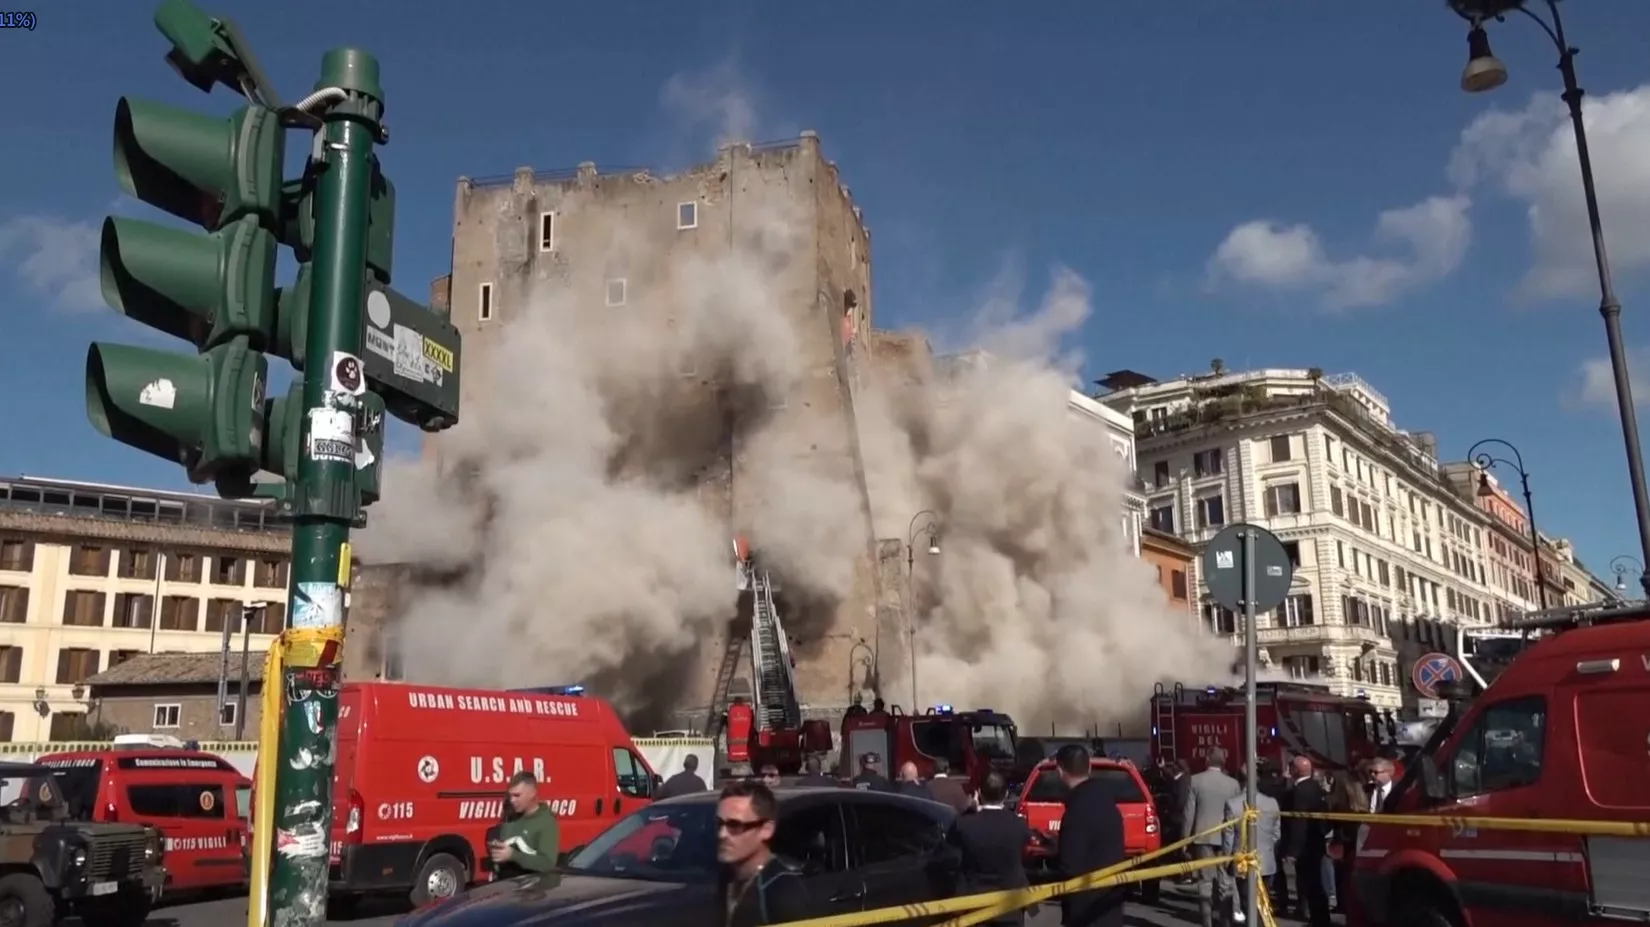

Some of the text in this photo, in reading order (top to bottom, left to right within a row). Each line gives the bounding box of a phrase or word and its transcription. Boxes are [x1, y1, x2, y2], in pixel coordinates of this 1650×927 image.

[408, 692, 579, 716] URBAN SEARCH AND RESCUE
[470, 756, 551, 783] U.S.AR.
[392, 802, 414, 819] 115
[197, 836, 227, 850] VIGILI
